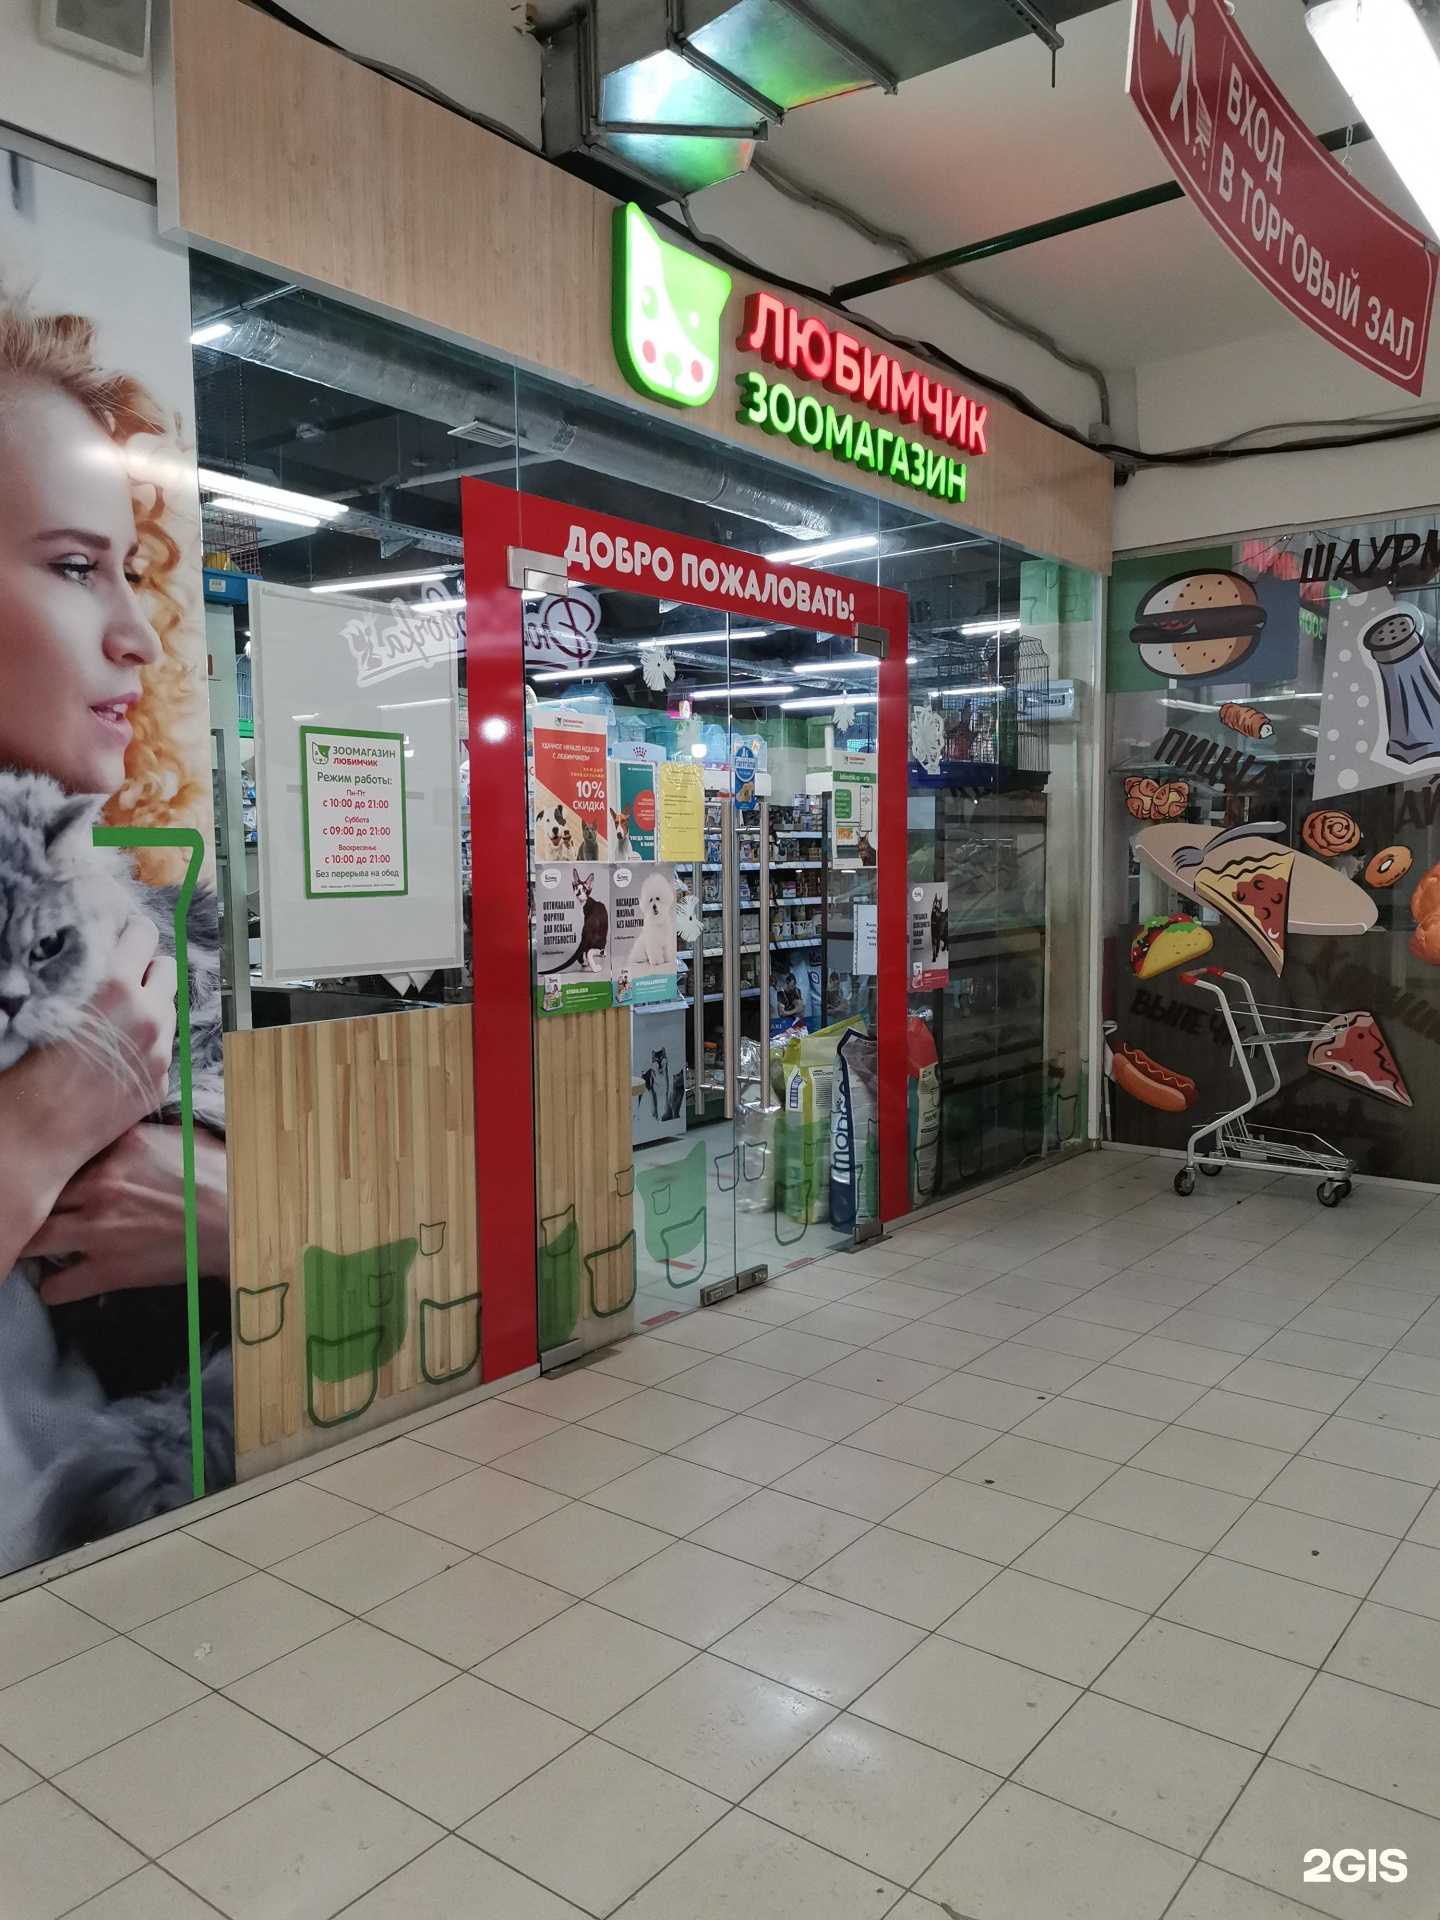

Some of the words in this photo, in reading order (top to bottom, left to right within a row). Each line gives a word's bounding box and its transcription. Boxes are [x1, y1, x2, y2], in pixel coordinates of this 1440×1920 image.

[1226, 62, 1286, 196] ВХОД
[1218, 142, 1235, 203] В
[1240, 168, 1362, 328] ТОРГОВЫЙ
[1364, 294, 1415, 362] ЗАЛ
[741, 291, 989, 456] ЛЮБИМЧИК
[740, 370, 969, 504] ЗООМАГАЗИН
[563, 524, 675, 583] ДОБРО
[681, 552, 856, 622] ПОЖАЛОВАТЬ!
[332, 746, 396, 759] ЗООМАГАЗИН
[333, 757, 378, 768] ЛЮБИМЧИК
[317, 771, 352, 783] Режим
[354, 774, 393, 786] работы:
[346, 789, 366, 797] Пн-Пт
[576, 780, 605, 799] 10%
[330, 798, 353, 808] 10:00
[355, 801, 366, 810] до
[368, 799, 389, 809] 21:00
[572, 800, 605, 813] СКИДКА
[344, 815, 370, 824] Суббота
[329, 826, 354, 836] 09:00
[356, 829, 367, 837] до
[369, 826, 391, 836] 21:00
[324, 856, 330, 864] с
[331, 854, 354, 864] 10:00
[356, 856, 367, 865] до
[369, 854, 391, 864] 21:00
[315, 869, 329, 878] Без
[331, 870, 369, 879] перерыва
[382, 868, 400, 878] обед
